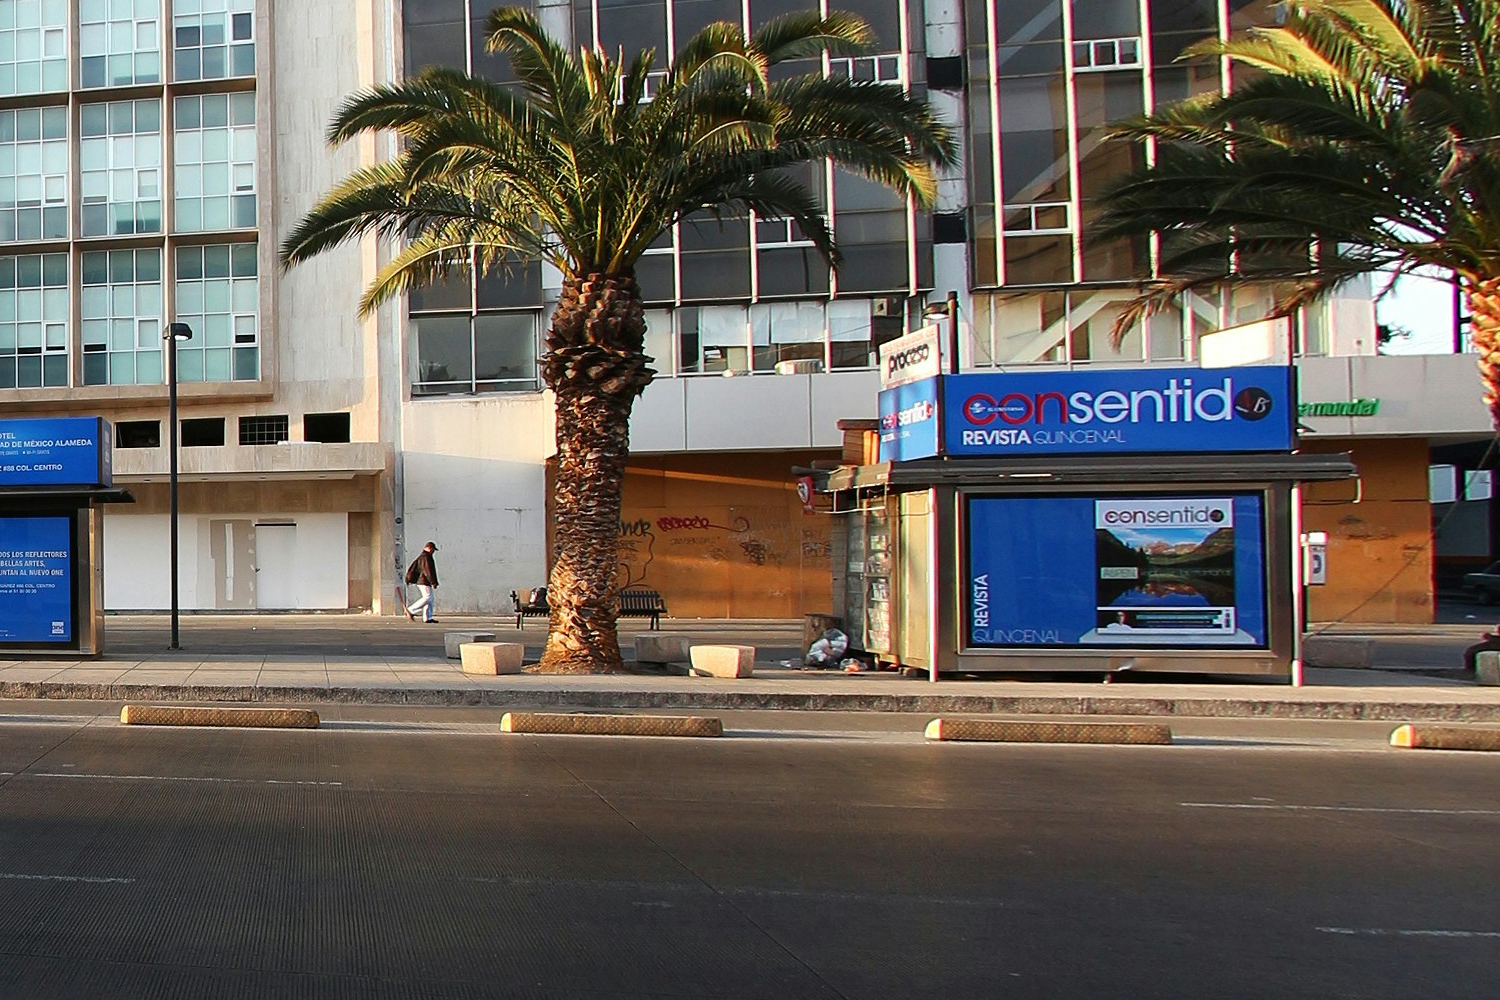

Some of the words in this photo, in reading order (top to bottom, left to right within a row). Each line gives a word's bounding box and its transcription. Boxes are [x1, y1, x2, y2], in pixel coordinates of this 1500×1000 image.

[888, 344, 930, 379] proceso
[11, 440, 23, 448] DE
[23, 438, 54, 448] MÉXICO
[54, 438, 93, 447] ALAMEDA
[963, 430, 1032, 446] REVISTA
[1033, 430, 1126, 444] QUINCENAL
[16, 464, 32, 472] COL.
[33, 463, 63, 471] CENTRO
[23, 560, 46, 568] ARTES,
[974, 574, 989, 627] REVISTA
[973, 629, 1063, 643] QUINCENAL
